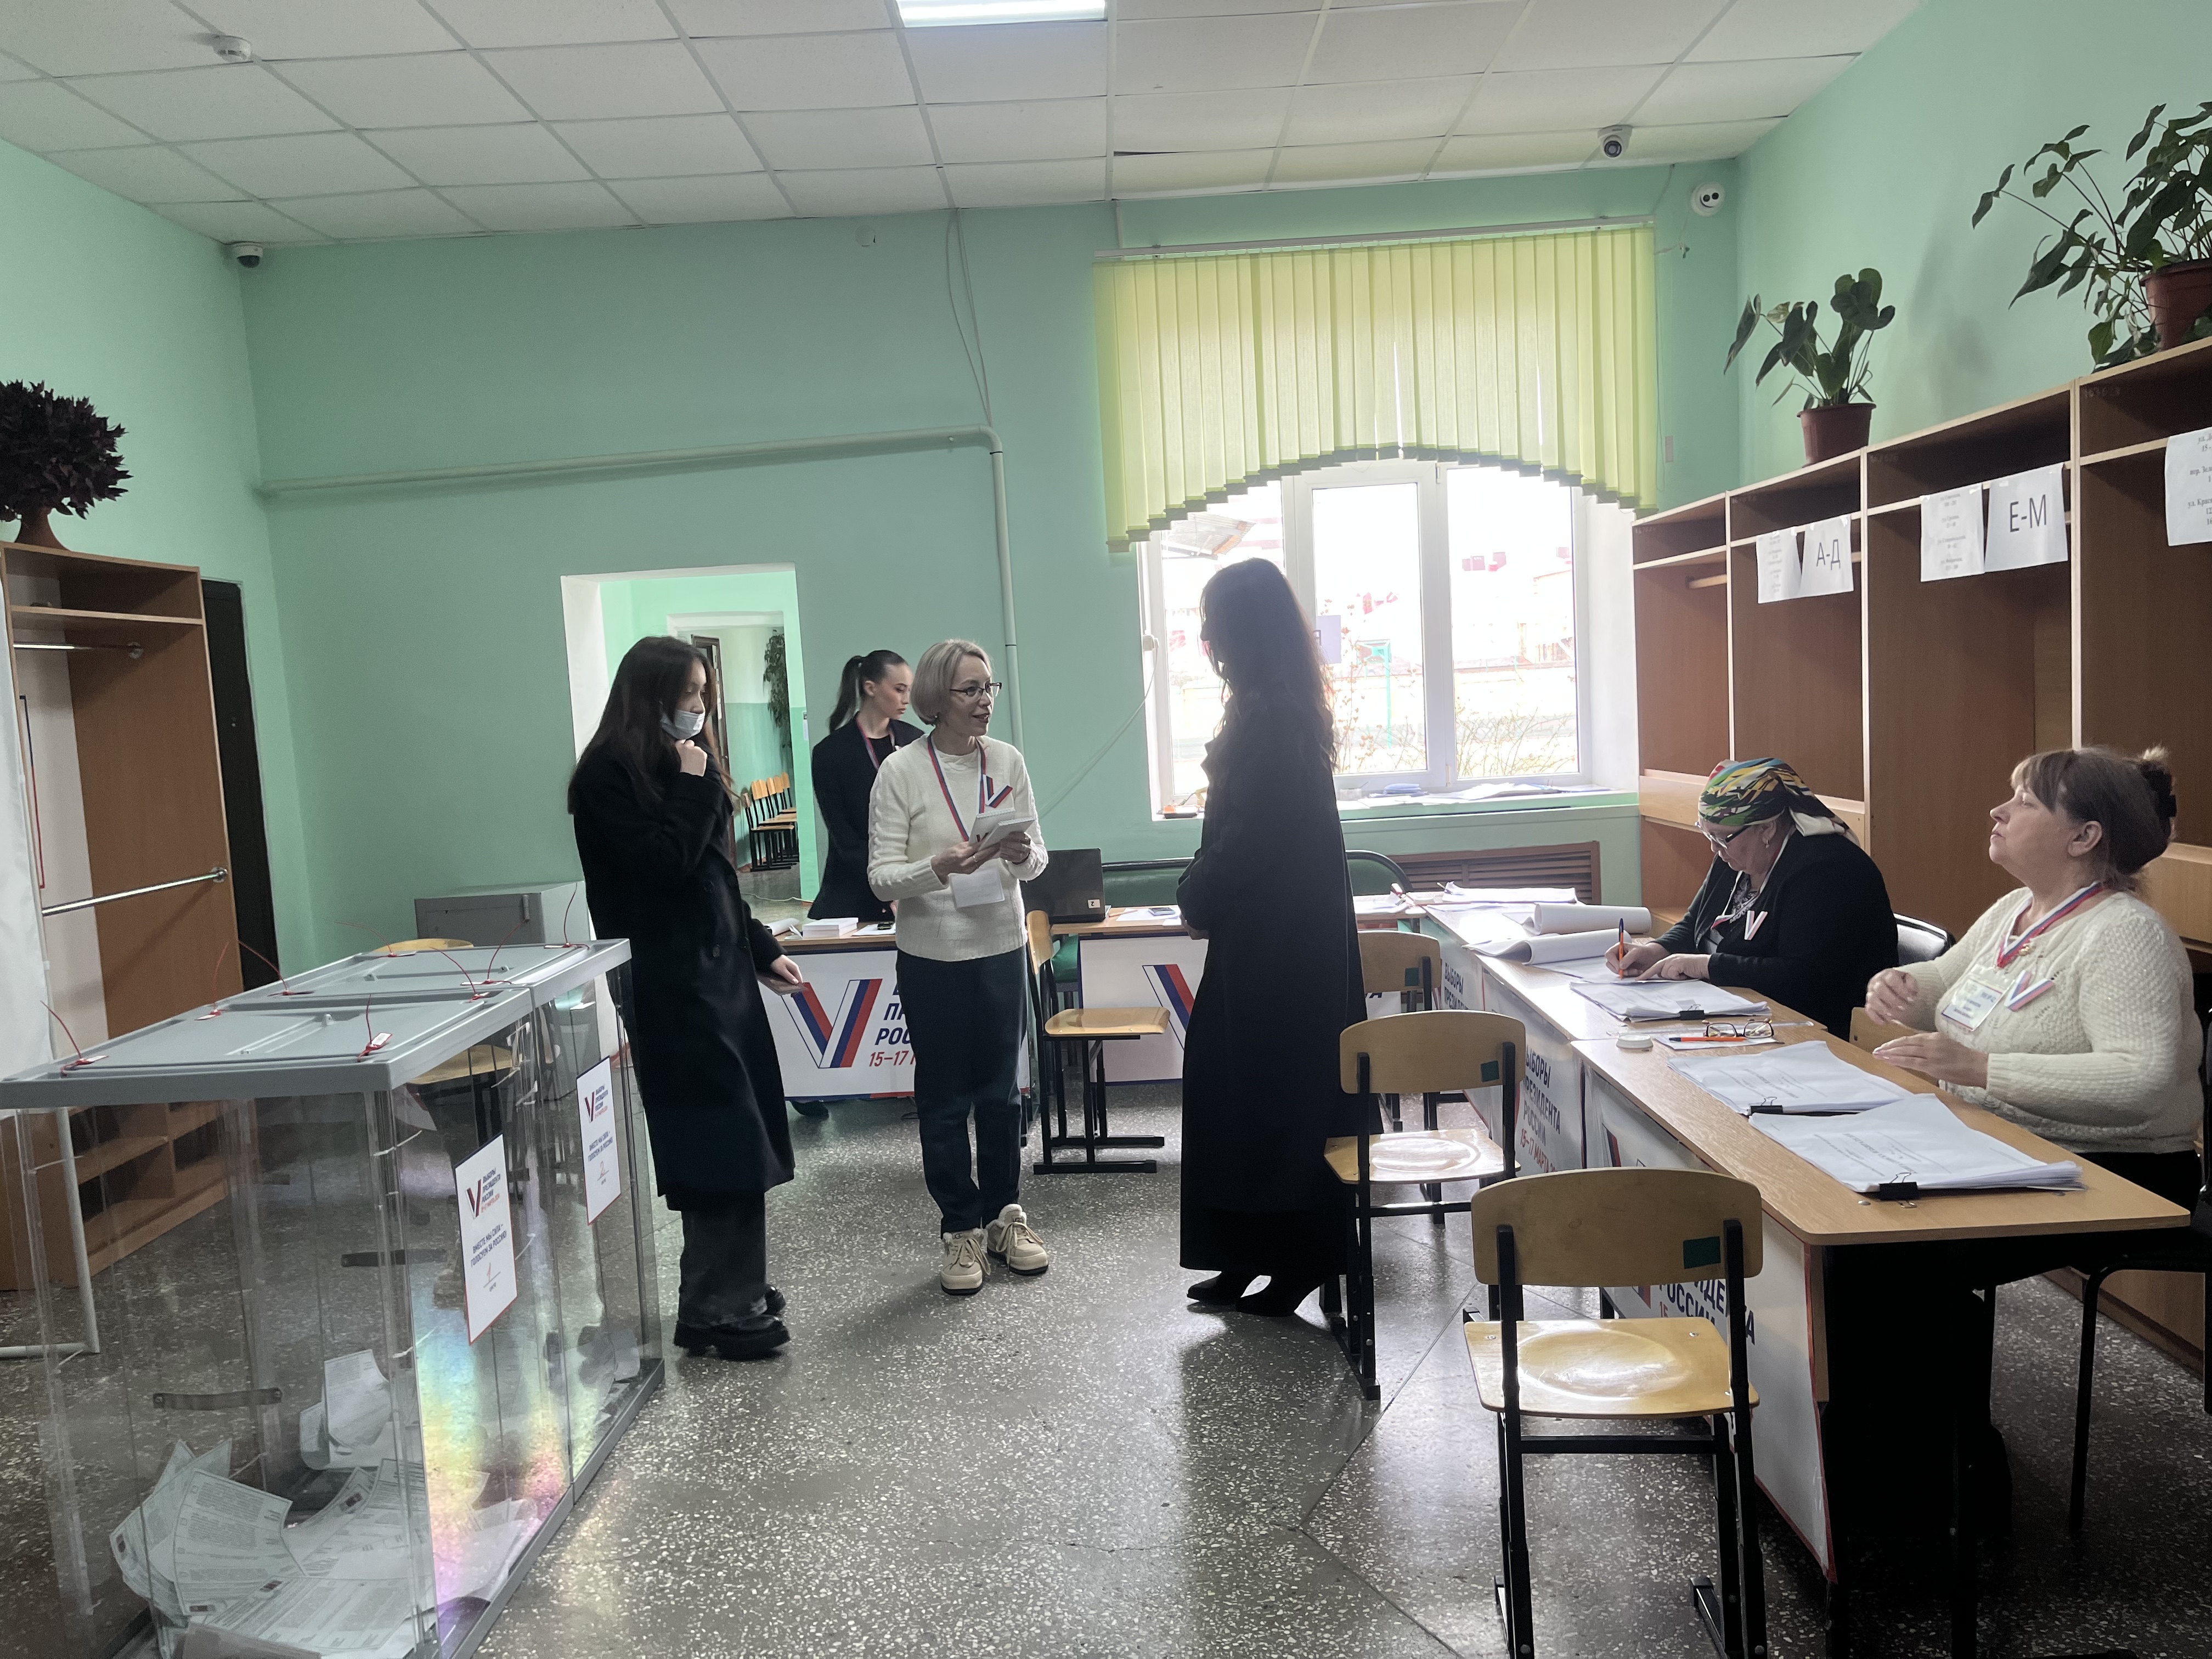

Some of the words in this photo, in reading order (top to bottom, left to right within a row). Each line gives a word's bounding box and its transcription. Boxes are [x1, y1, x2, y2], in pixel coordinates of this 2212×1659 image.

[2010, 494, 2046, 533] Е-М
[1816, 539, 1841, 571] А-Д
[1444, 962, 1464, 995] ВЫБОРЫ
[1526, 1044, 1551, 1088] ЫБОРЫ
[1523, 1100, 1546, 1147] РОССИИ
[471, 1246, 488, 1268] ГОЛОСУЕМ
[488, 1243, 493, 1252] ЗА
[473, 1237, 486, 1254] ВМЕСТЕ
[486, 1231, 492, 1243] МЫ
[492, 1224, 501, 1237] СИЛА
